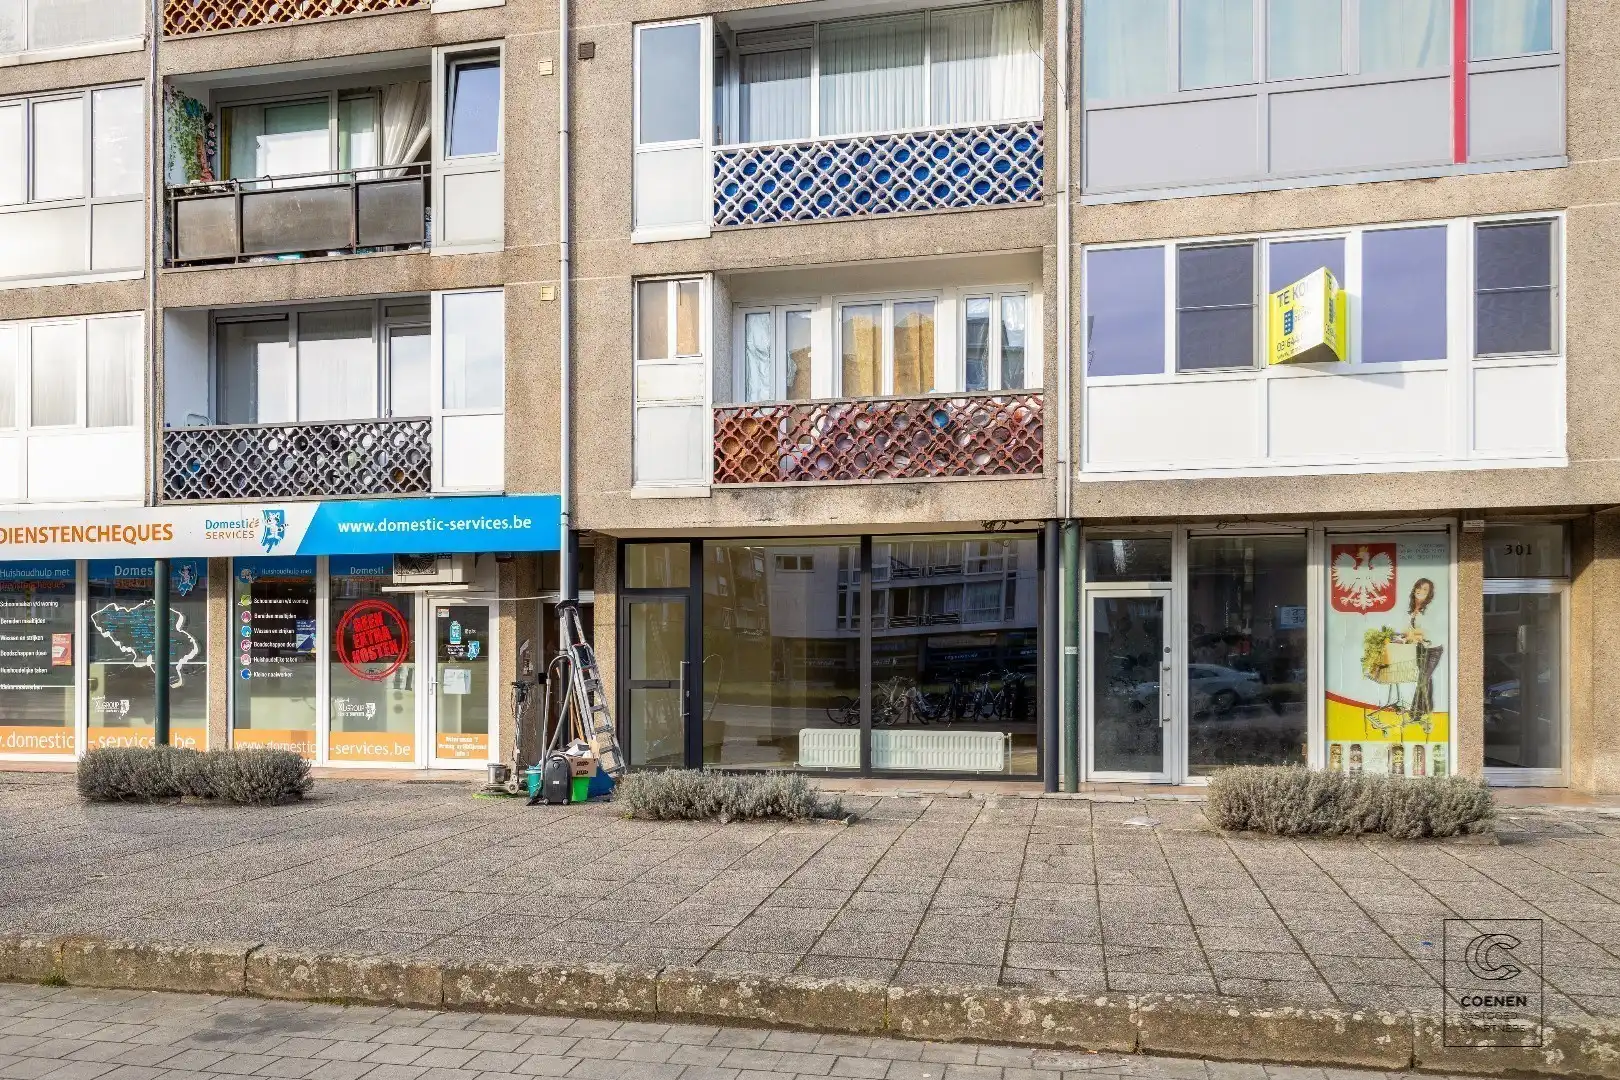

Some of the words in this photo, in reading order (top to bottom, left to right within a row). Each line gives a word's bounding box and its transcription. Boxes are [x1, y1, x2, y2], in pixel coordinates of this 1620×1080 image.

[1277, 290, 1290, 308] TE
[205, 518, 258, 530] Domestic
[338, 514, 532, 533] www.domestic-services.be
[0, 523, 173, 545] DIENSTENCHEQUES
[205, 529, 255, 540] SERVICES
[1504, 543, 1533, 556] 301
[54, 568, 70, 577] met
[351, 639, 399, 664] KOSTEN
[0, 731, 75, 748] .domestic
